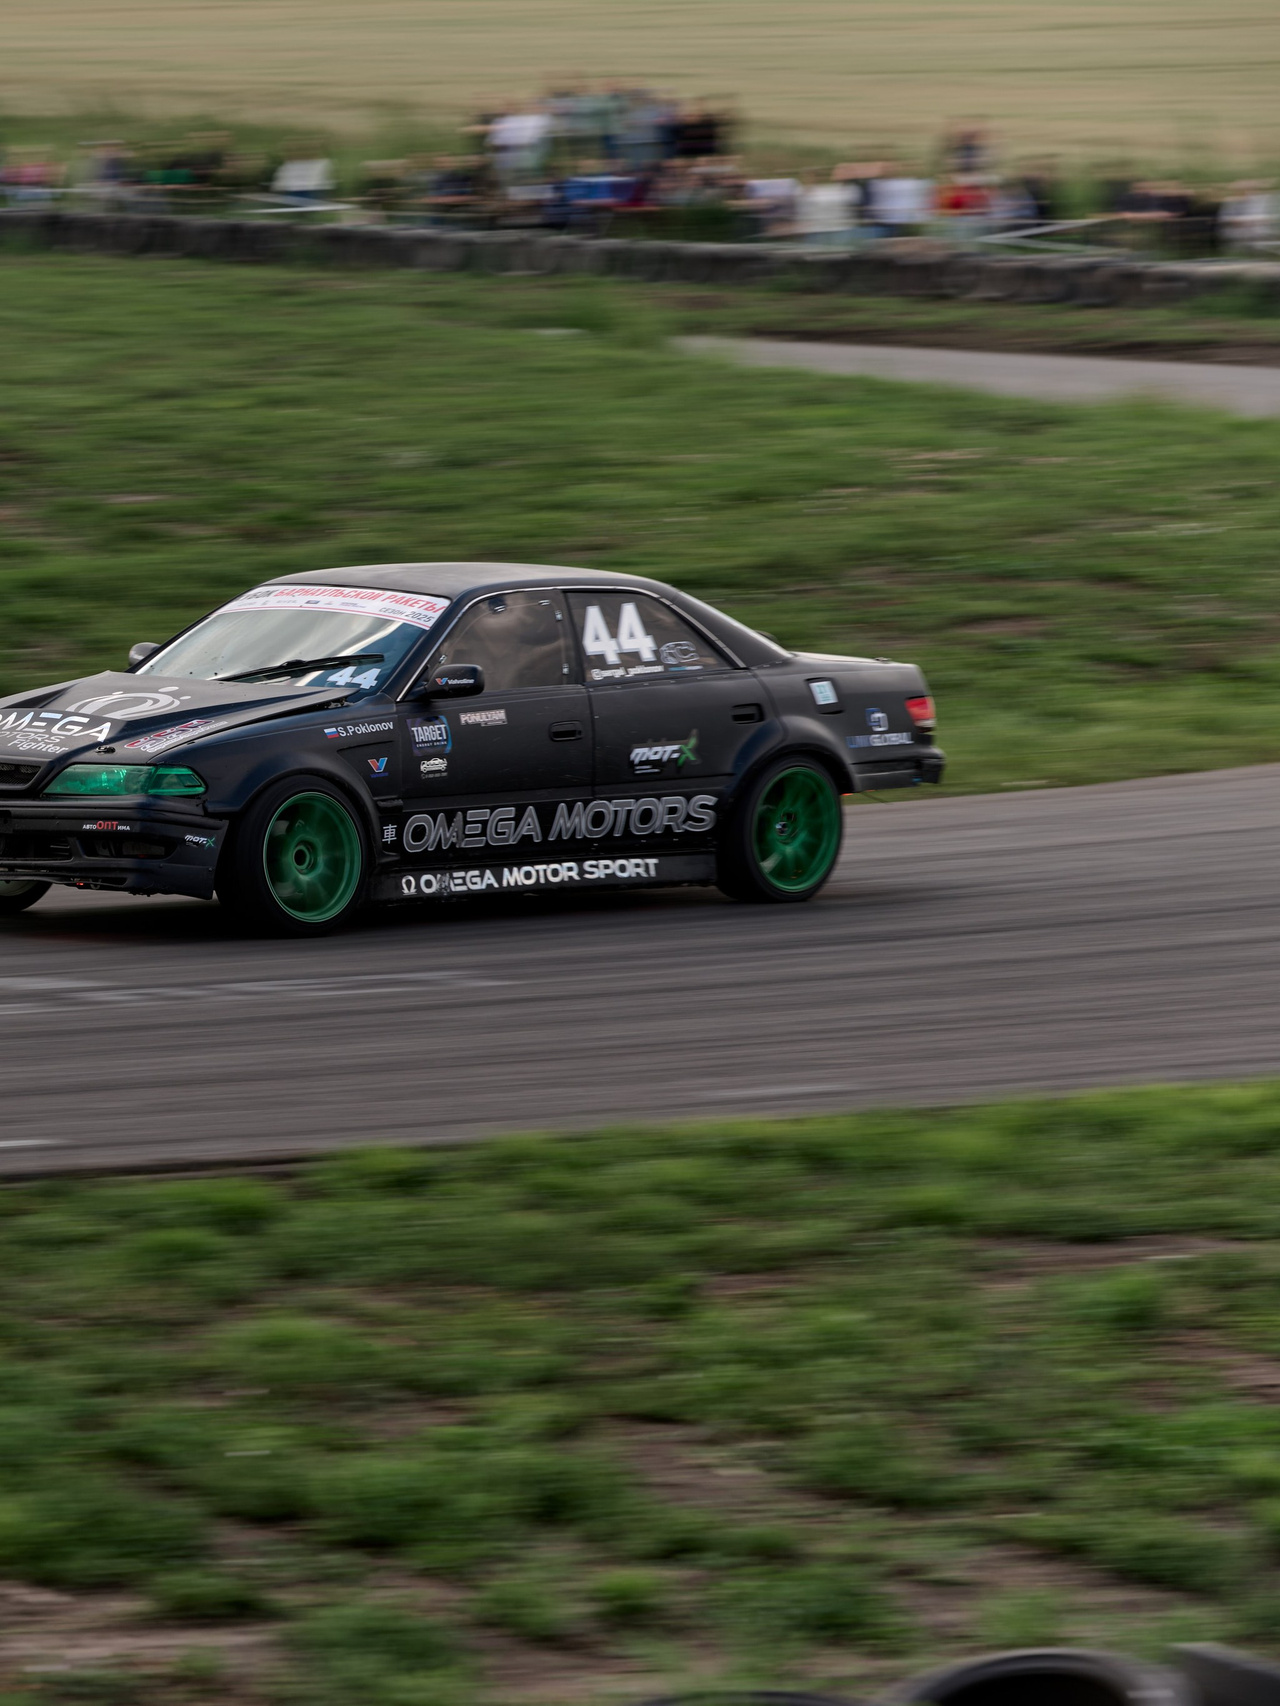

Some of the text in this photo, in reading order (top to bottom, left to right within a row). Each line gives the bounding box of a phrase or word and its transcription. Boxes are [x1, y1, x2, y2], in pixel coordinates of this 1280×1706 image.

[381, 594, 446, 613] РАКЕТЫ
[404, 610, 435, 623] 2025
[582, 602, 657, 665] 44
[326, 666, 381, 689] 44
[338, 721, 393, 737] S.Poklonov
[411, 725, 447, 742] TARGET
[8, 738, 70, 754] Fighter
[404, 795, 718, 852] OMEGA MOTORS
[382, 824, 397, 844] 車
[502, 862, 581, 887] MOTOR
[583, 858, 659, 879] SPORT
